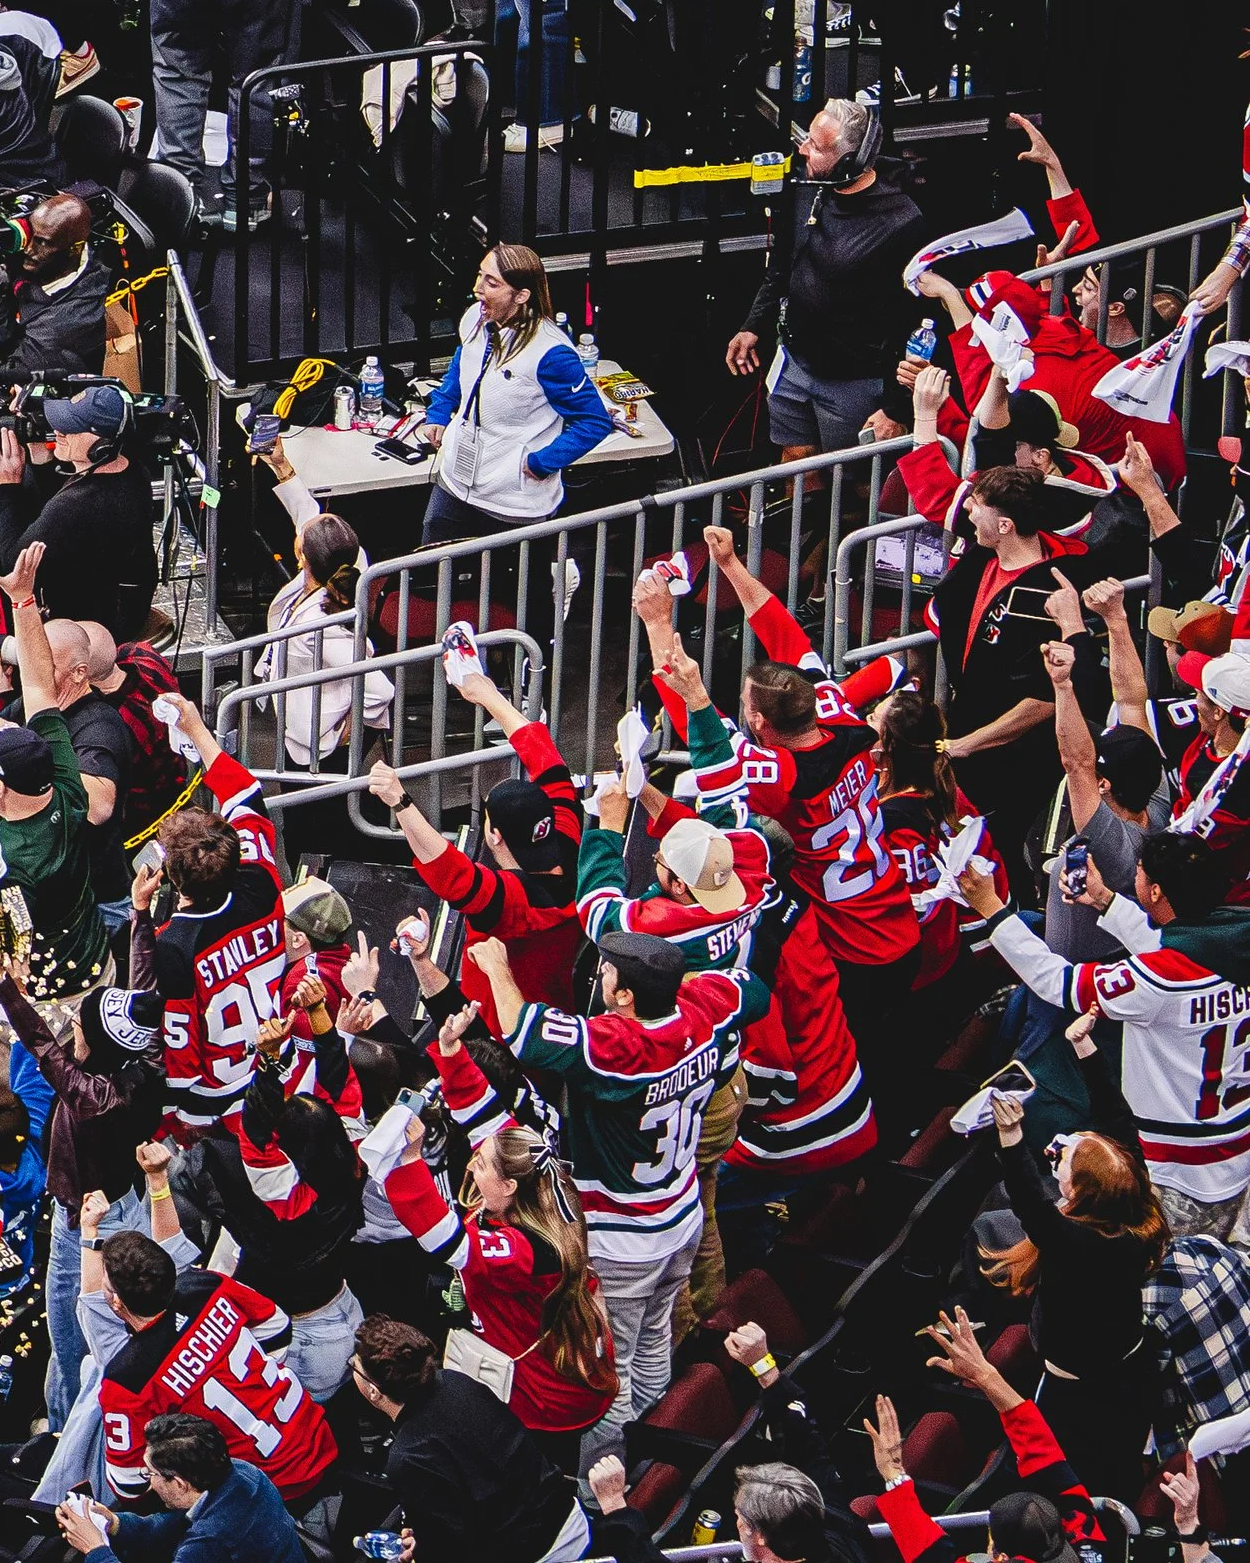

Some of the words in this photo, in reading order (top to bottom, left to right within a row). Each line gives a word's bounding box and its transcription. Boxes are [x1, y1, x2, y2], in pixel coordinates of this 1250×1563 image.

[828, 759, 867, 819] MEIER
[196, 919, 279, 989] STANLEY
[164, 1011, 188, 1049] 5
[644, 1048, 718, 1105] BRODEUR
[631, 1079, 716, 1185] 30
[159, 1296, 240, 1397] HISCHIER
[202, 1326, 304, 1458] 13
[104, 1411, 131, 1452] 3
